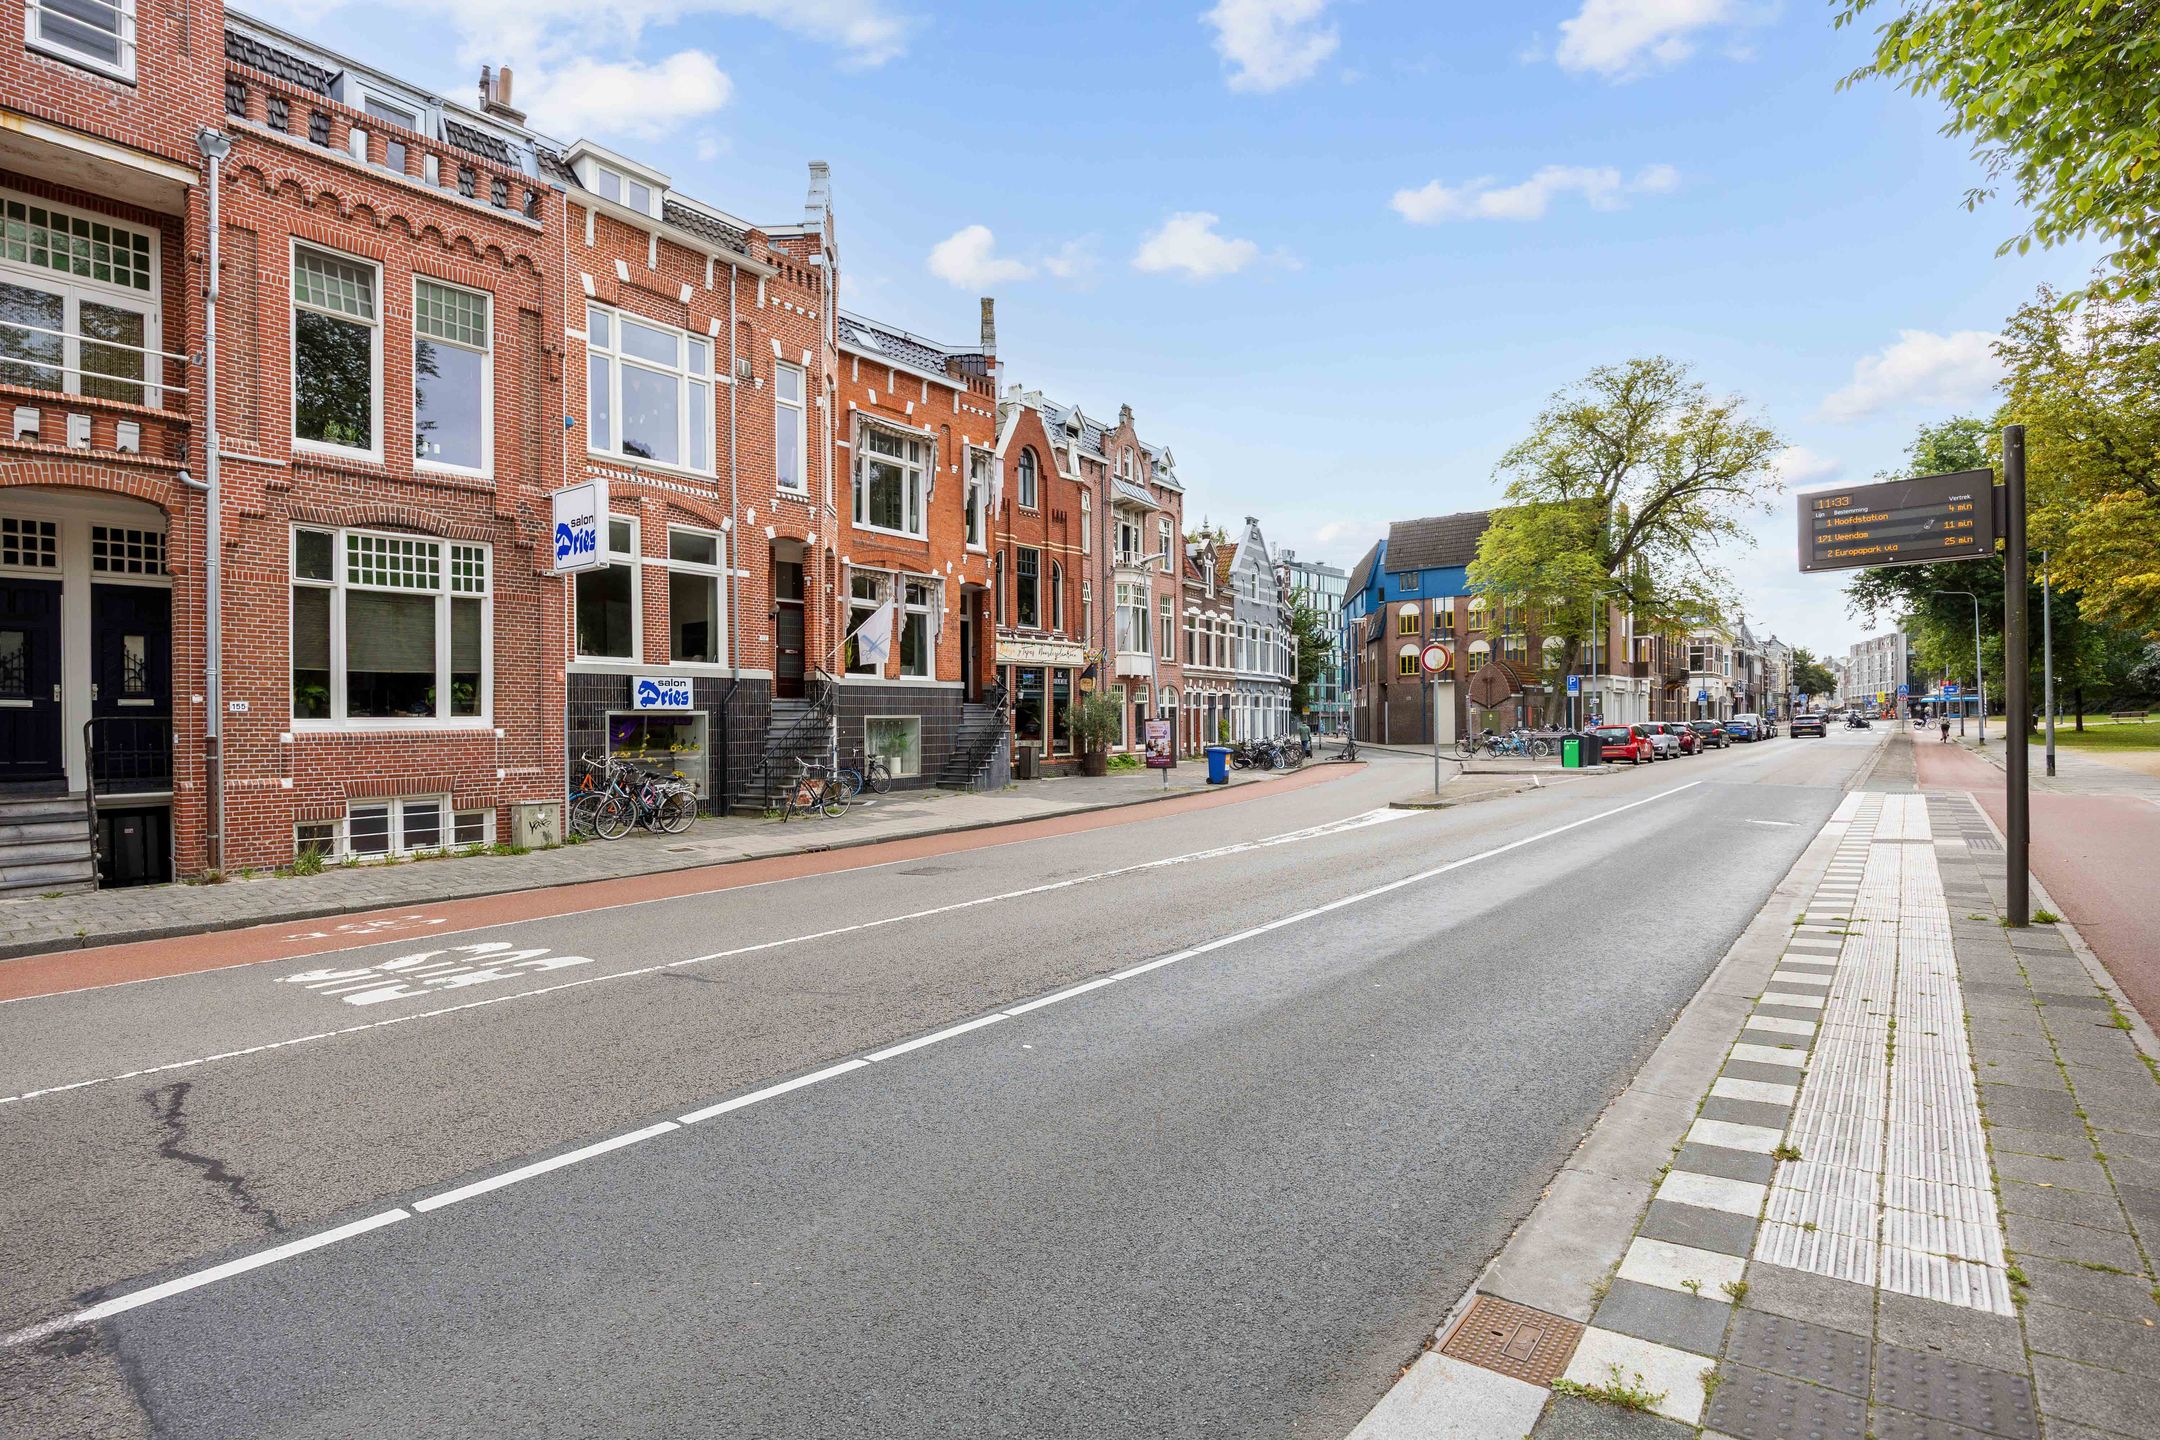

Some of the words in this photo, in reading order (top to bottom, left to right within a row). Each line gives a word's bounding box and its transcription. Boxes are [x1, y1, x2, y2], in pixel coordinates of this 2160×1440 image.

[1818, 496, 1849, 509] 11:33
[1827, 519, 1832, 528] 1
[1834, 513, 1889, 526] Hoofdstation
[1948, 504, 1954, 512] 4
[1834, 507, 1869, 516] Bestemming
[571, 514, 594, 528] salon
[1817, 534, 1833, 543] 171
[1834, 531, 1869, 541] Veendam
[1943, 520, 1955, 529] 11
[555, 522, 596, 561] Dries
[1828, 549, 1833, 558] 2
[1835, 545, 1881, 557] Europapark
[1944, 537, 1956, 545] 25
[657, 678, 687, 687] salon
[1569, 677, 1576, 685] P
[638, 680, 689, 708] Dries
